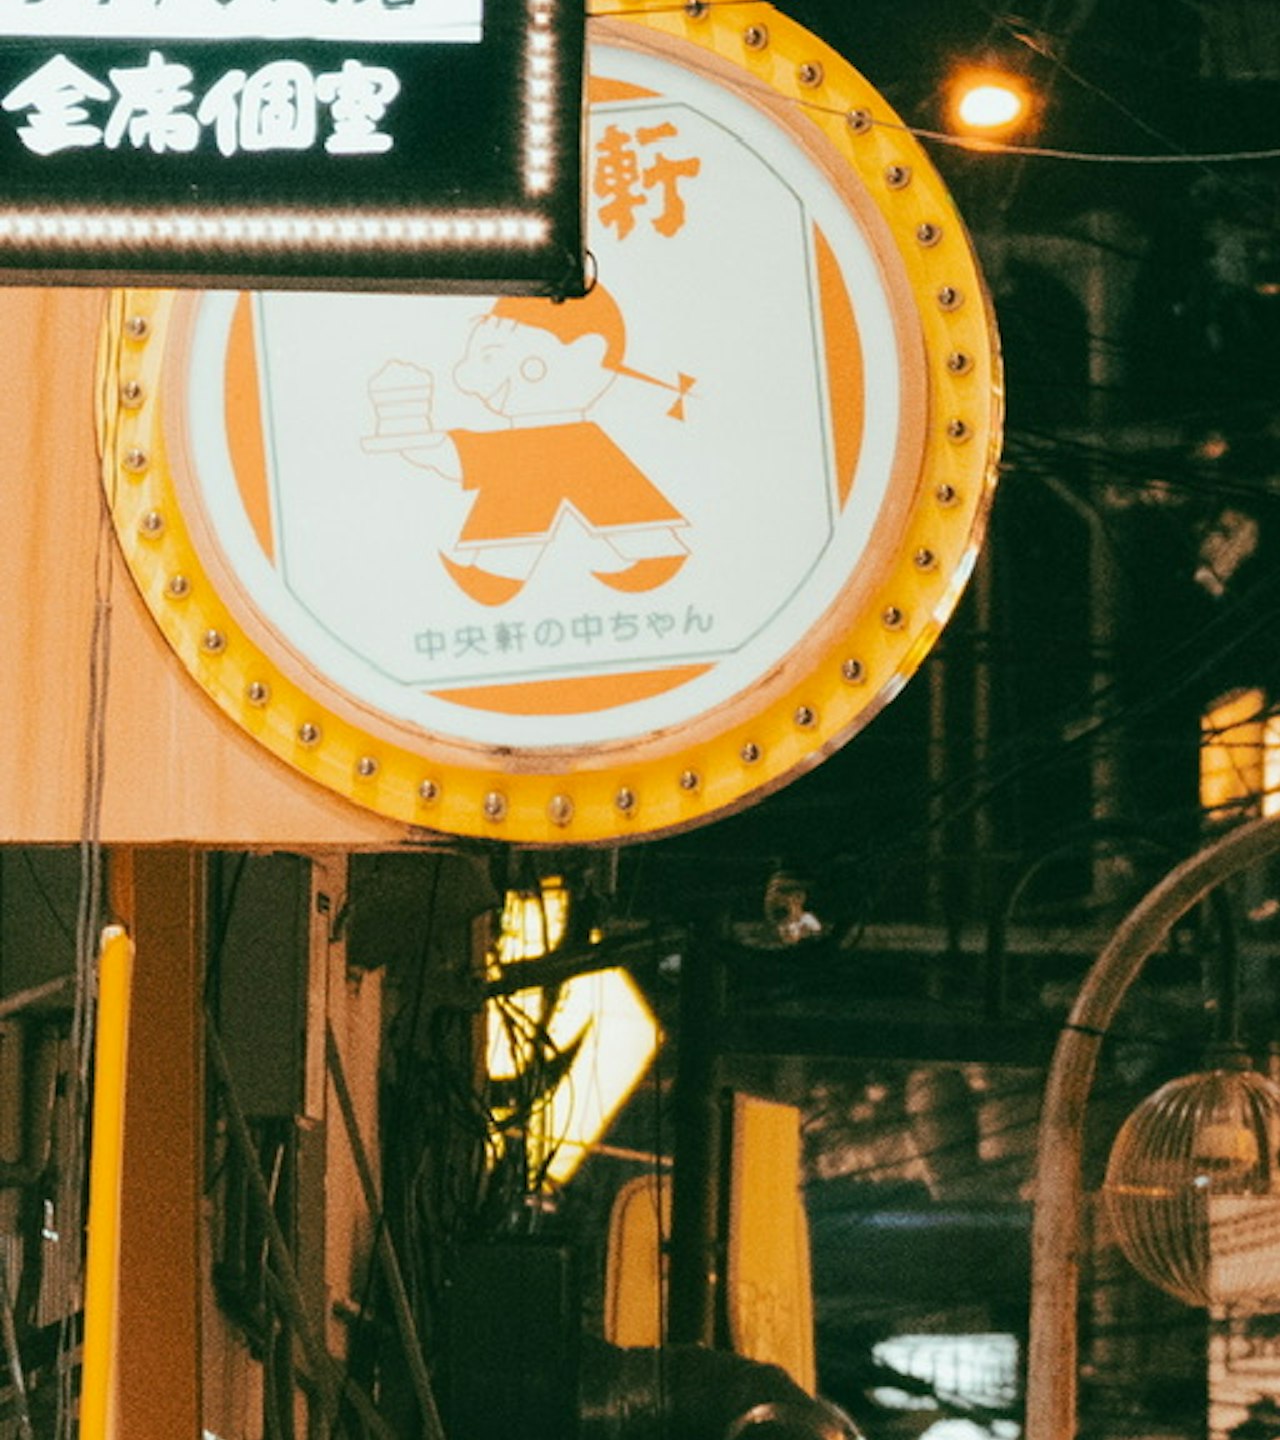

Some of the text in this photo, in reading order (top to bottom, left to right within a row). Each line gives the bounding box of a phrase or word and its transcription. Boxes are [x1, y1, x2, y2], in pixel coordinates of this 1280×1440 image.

[2, 52, 401, 157] 全席個室
[414, 607, 715, 661] 中央軒の中ちゃん
